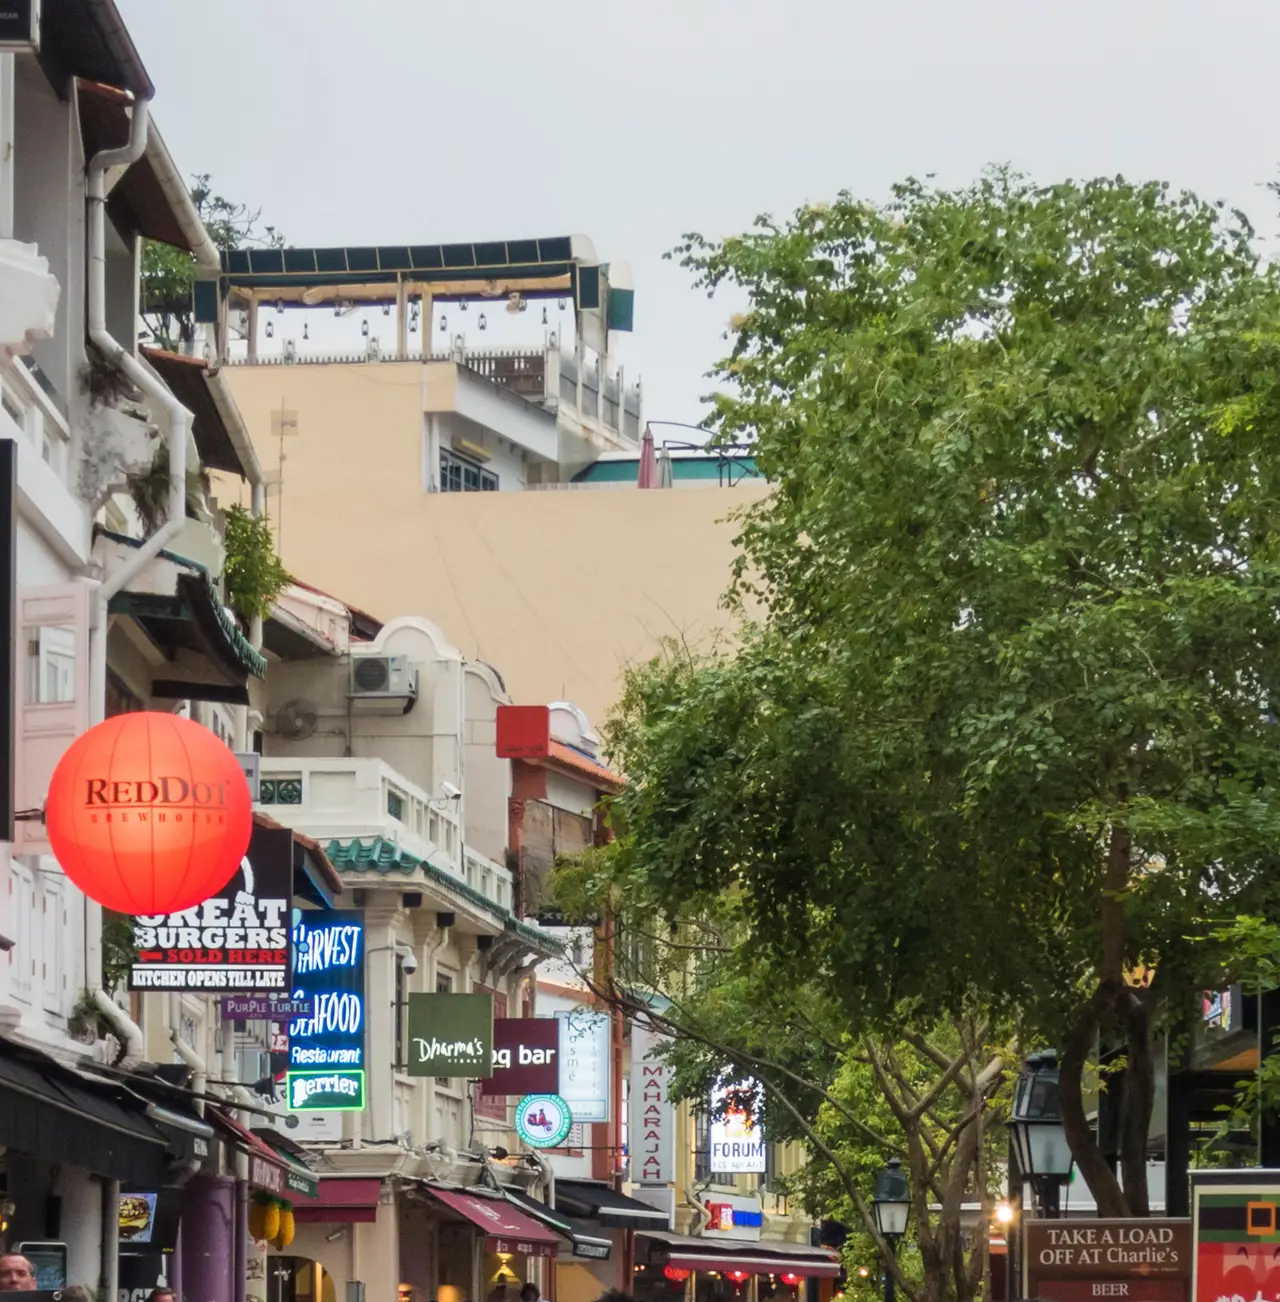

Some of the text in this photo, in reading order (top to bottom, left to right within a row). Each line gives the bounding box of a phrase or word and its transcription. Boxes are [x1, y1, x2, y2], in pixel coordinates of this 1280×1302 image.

[135, 927, 287, 950] BURGERS
[167, 949, 287, 964] SOLD HERE
[132, 970, 285, 988] KITCHEN OPENS TILL LATE
[291, 1047, 360, 1064] Restaurant
[413, 1038, 483, 1062] Dharma's
[518, 1045, 556, 1065] bar
[292, 1075, 359, 1108] Perrier
[642, 1066, 662, 1179] MAHARAJAH
[713, 1142, 763, 1157] FORUM
[1047, 1228, 1173, 1245] TAKE A LOAD
[1040, 1247, 1179, 1265] OFF AT Charlie's
[1092, 1283, 1129, 1296] BEER
